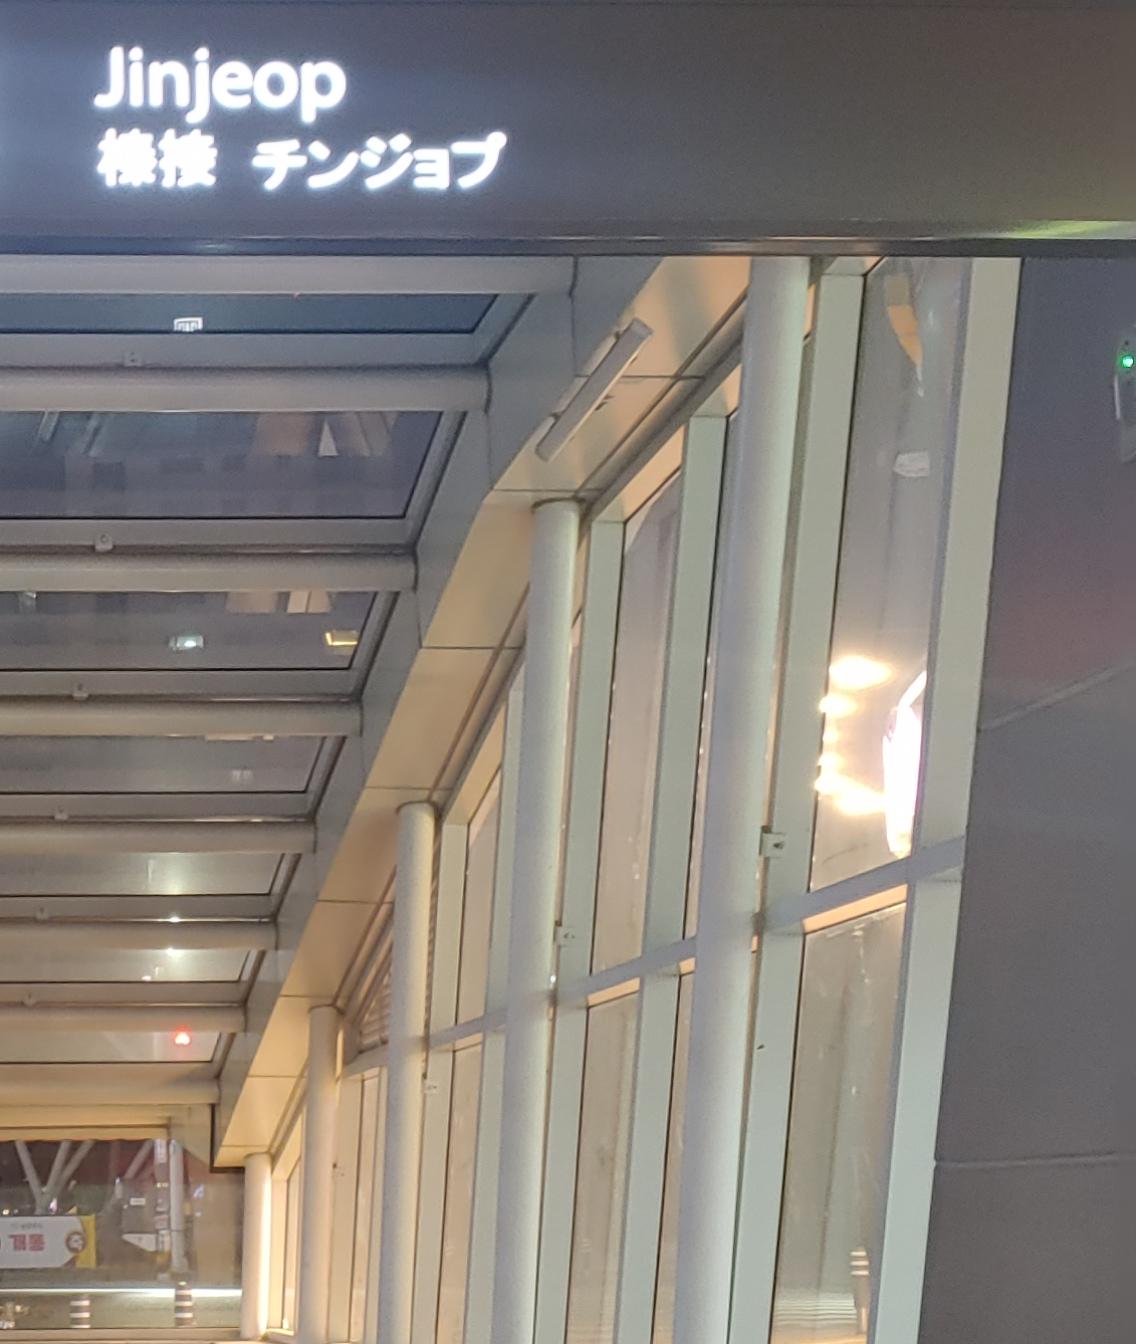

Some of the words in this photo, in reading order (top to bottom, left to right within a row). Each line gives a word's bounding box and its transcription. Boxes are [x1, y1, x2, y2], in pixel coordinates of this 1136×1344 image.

[94, 45, 347, 124] Jinjeop
[252, 131, 507, 191] チンジョプ
